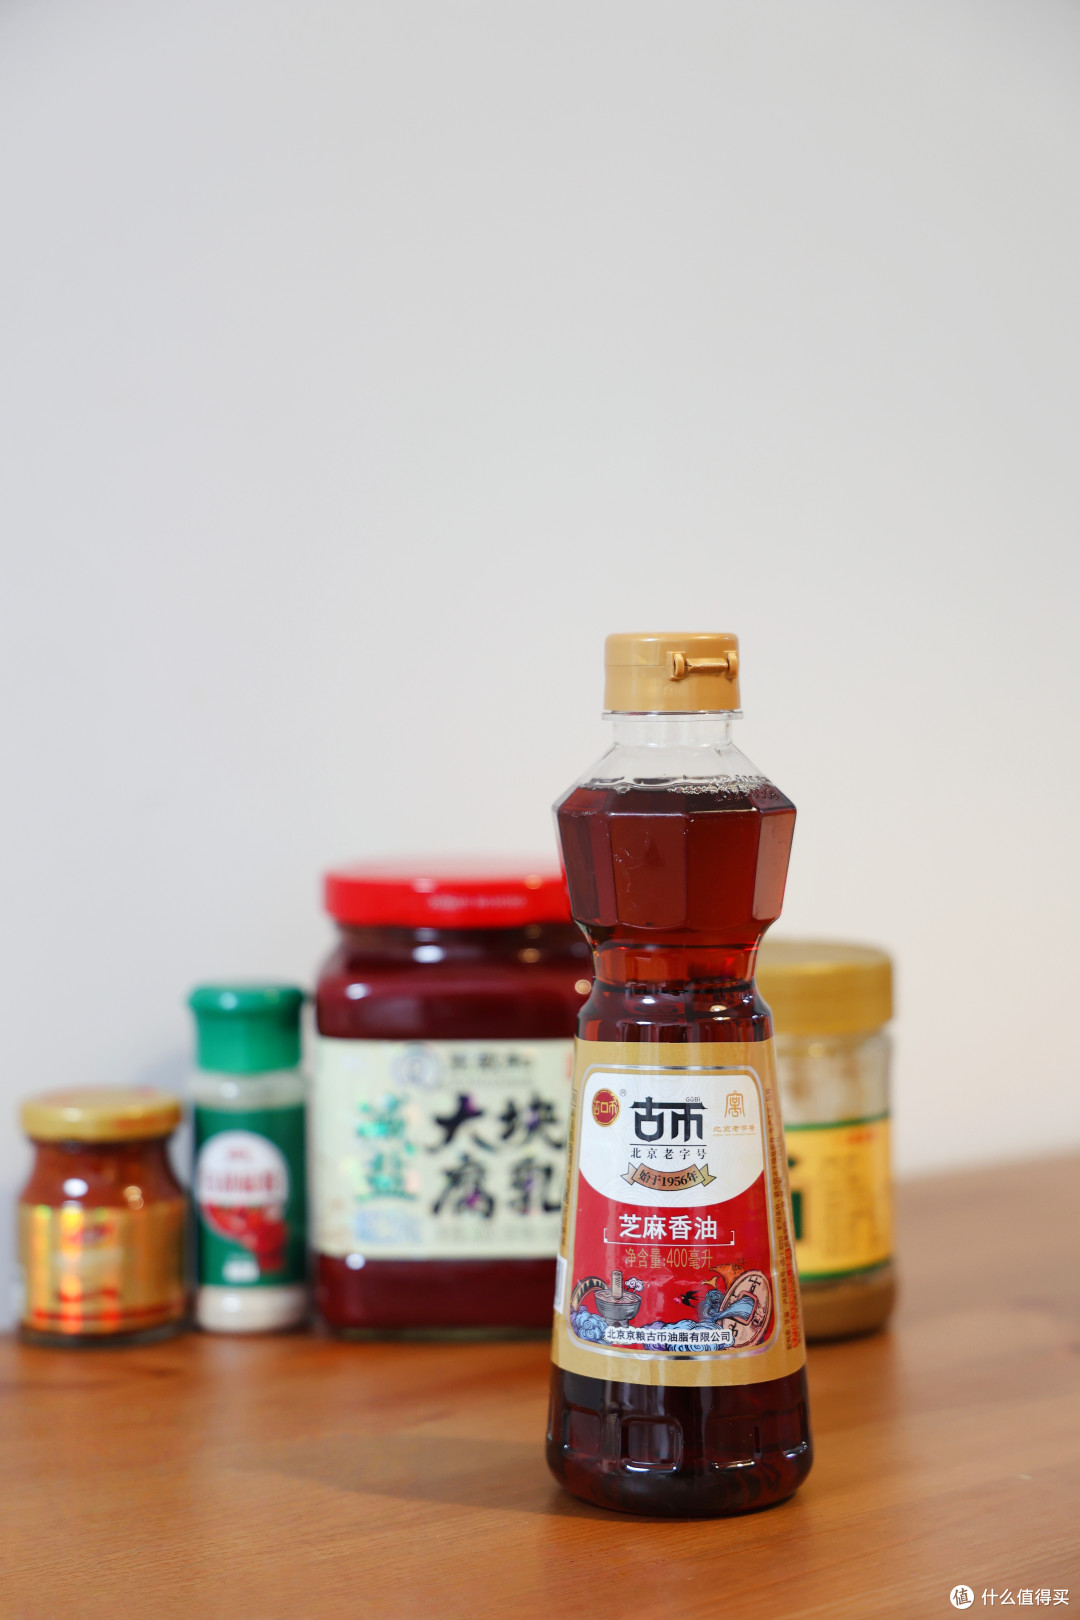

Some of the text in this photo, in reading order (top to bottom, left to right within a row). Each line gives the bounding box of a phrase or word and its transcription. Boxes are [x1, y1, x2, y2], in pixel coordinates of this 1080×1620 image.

[426, 1093, 566, 1154] 大块
[630, 1147, 707, 1160] 北京老字号
[432, 1154, 562, 1219] 腐乳
[638, 1169, 699, 1187] 始于1956年
[618, 1213, 717, 1240] 芝麻香油
[624, 1247, 713, 1270] 净含量:400毫升
